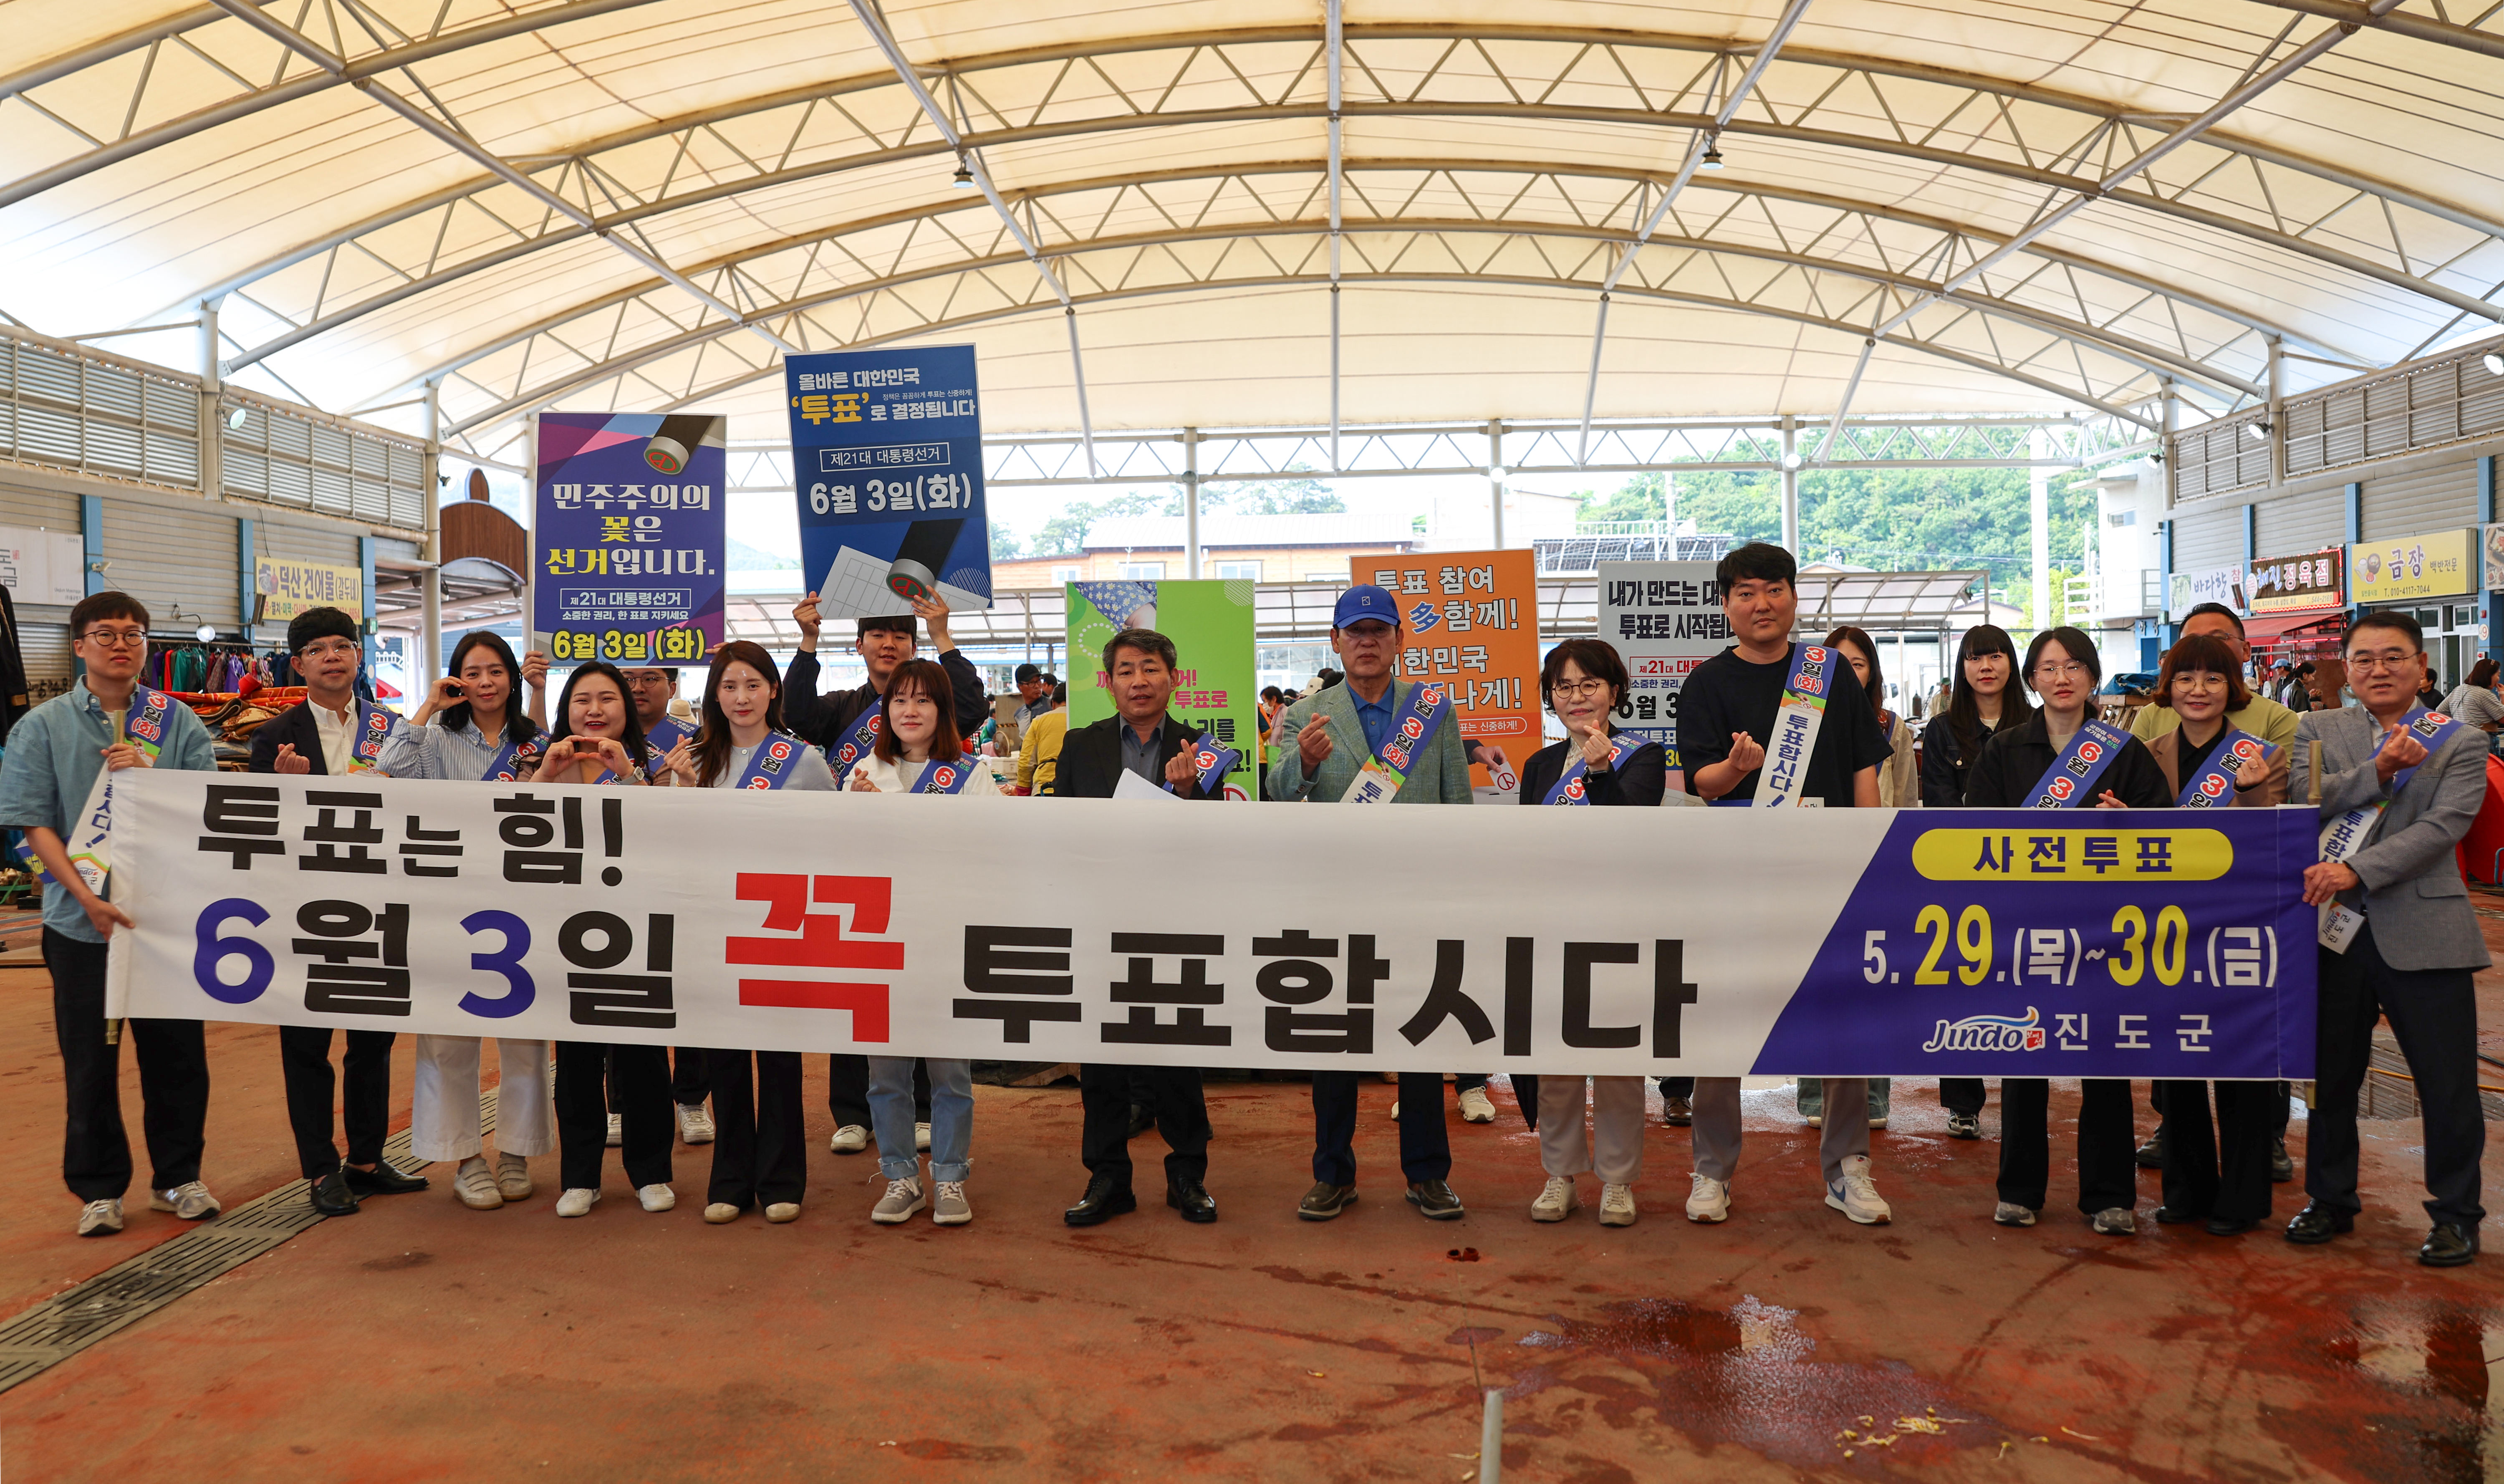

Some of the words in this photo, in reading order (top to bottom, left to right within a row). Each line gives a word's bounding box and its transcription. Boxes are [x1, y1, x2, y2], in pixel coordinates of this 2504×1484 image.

[799, 371, 848, 391] 올바른
[854, 368, 920, 388] 대한민국
[902, 391, 926, 400] 꼼꼼하게
[927, 390, 946, 398] 투표는
[947, 389, 973, 397] 신중하게!
[892, 399, 976, 420] 결정됩니다
[830, 450, 871, 466] 제21대
[877, 447, 940, 464] 대통령선거
[552, 484, 710, 510] 민주주의의
[810, 482, 858, 515] 6월
[600, 516, 663, 542] 꽃은
[545, 548, 715, 575] 선거입니다.
[2388, 544, 2425, 581] 금장
[2430, 558, 2458, 573] 백반전문
[280, 566, 301, 598] 덕산
[1374, 568, 1430, 595] 투표
[1439, 565, 1494, 595] 참여
[2194, 572, 2227, 600] 바다향
[2256, 564, 2282, 591] 해진
[2284, 559, 2329, 591] 정육점
[570, 591, 606, 606] 제21대
[609, 591, 681, 606] 대통령선거
[1608, 580, 1644, 606] 내가
[1648, 580, 1698, 606] 만드는
[2312, 595, 2332, 603] 544-2169
[2390, 585, 2431, 596] 010-4117-7044
[562, 610, 591, 621] 소중한
[593, 610, 615, 621] 권리,
[618, 611, 627, 620] 한
[629, 611, 649, 621] 표로
[651, 611, 689, 621] 지키세요
[1619, 614, 1670, 640] 투표로
[553, 629, 596, 659] 6월
[1391, 644, 1489, 677] 한민국
[1639, 660, 1674, 674] 제21대
[1677, 660, 1704, 673] 대통
[1631, 679, 1658, 689] 소중한
[1661, 679, 1681, 689] 권리,
[1175, 690, 1228, 709] 투표로
[1618, 692, 1657, 720] 6월
[1665, 692, 1680, 719] 3
[1459, 722, 1477, 732] 표는
[1480, 719, 1518, 732] 신중하게!
[198, 784, 464, 878] 투표는
[493, 793, 623, 886] 힘!
[1973, 835, 2173, 874] 사전투표
[194, 898, 412, 1016] 6월
[457, 910, 676, 1029] 3일
[725, 872, 905, 1043] 꼭
[952, 925, 1698, 1058] 투표합시다
[1922, 1018, 2027, 1052] Jindo
